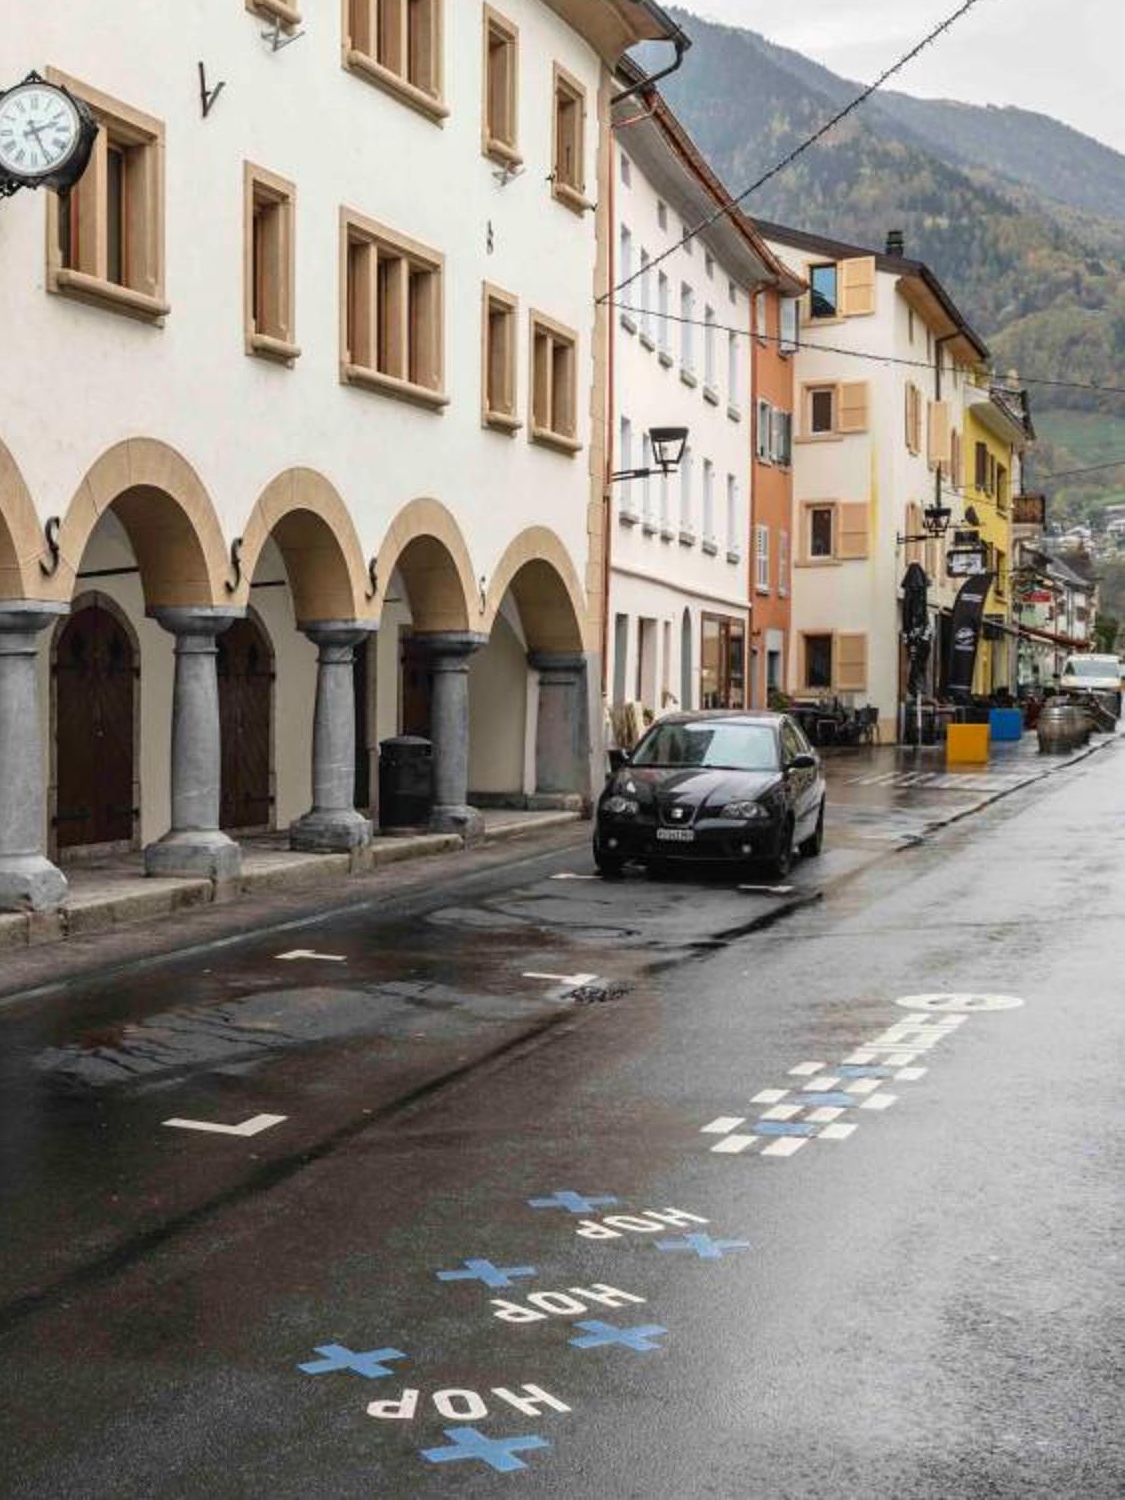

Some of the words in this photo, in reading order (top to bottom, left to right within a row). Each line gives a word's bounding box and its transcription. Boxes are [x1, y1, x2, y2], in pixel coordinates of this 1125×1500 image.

[576, 1207, 711, 1239] HOP
[490, 1283, 647, 1323] HOP
[366, 1383, 572, 1420] HOP
